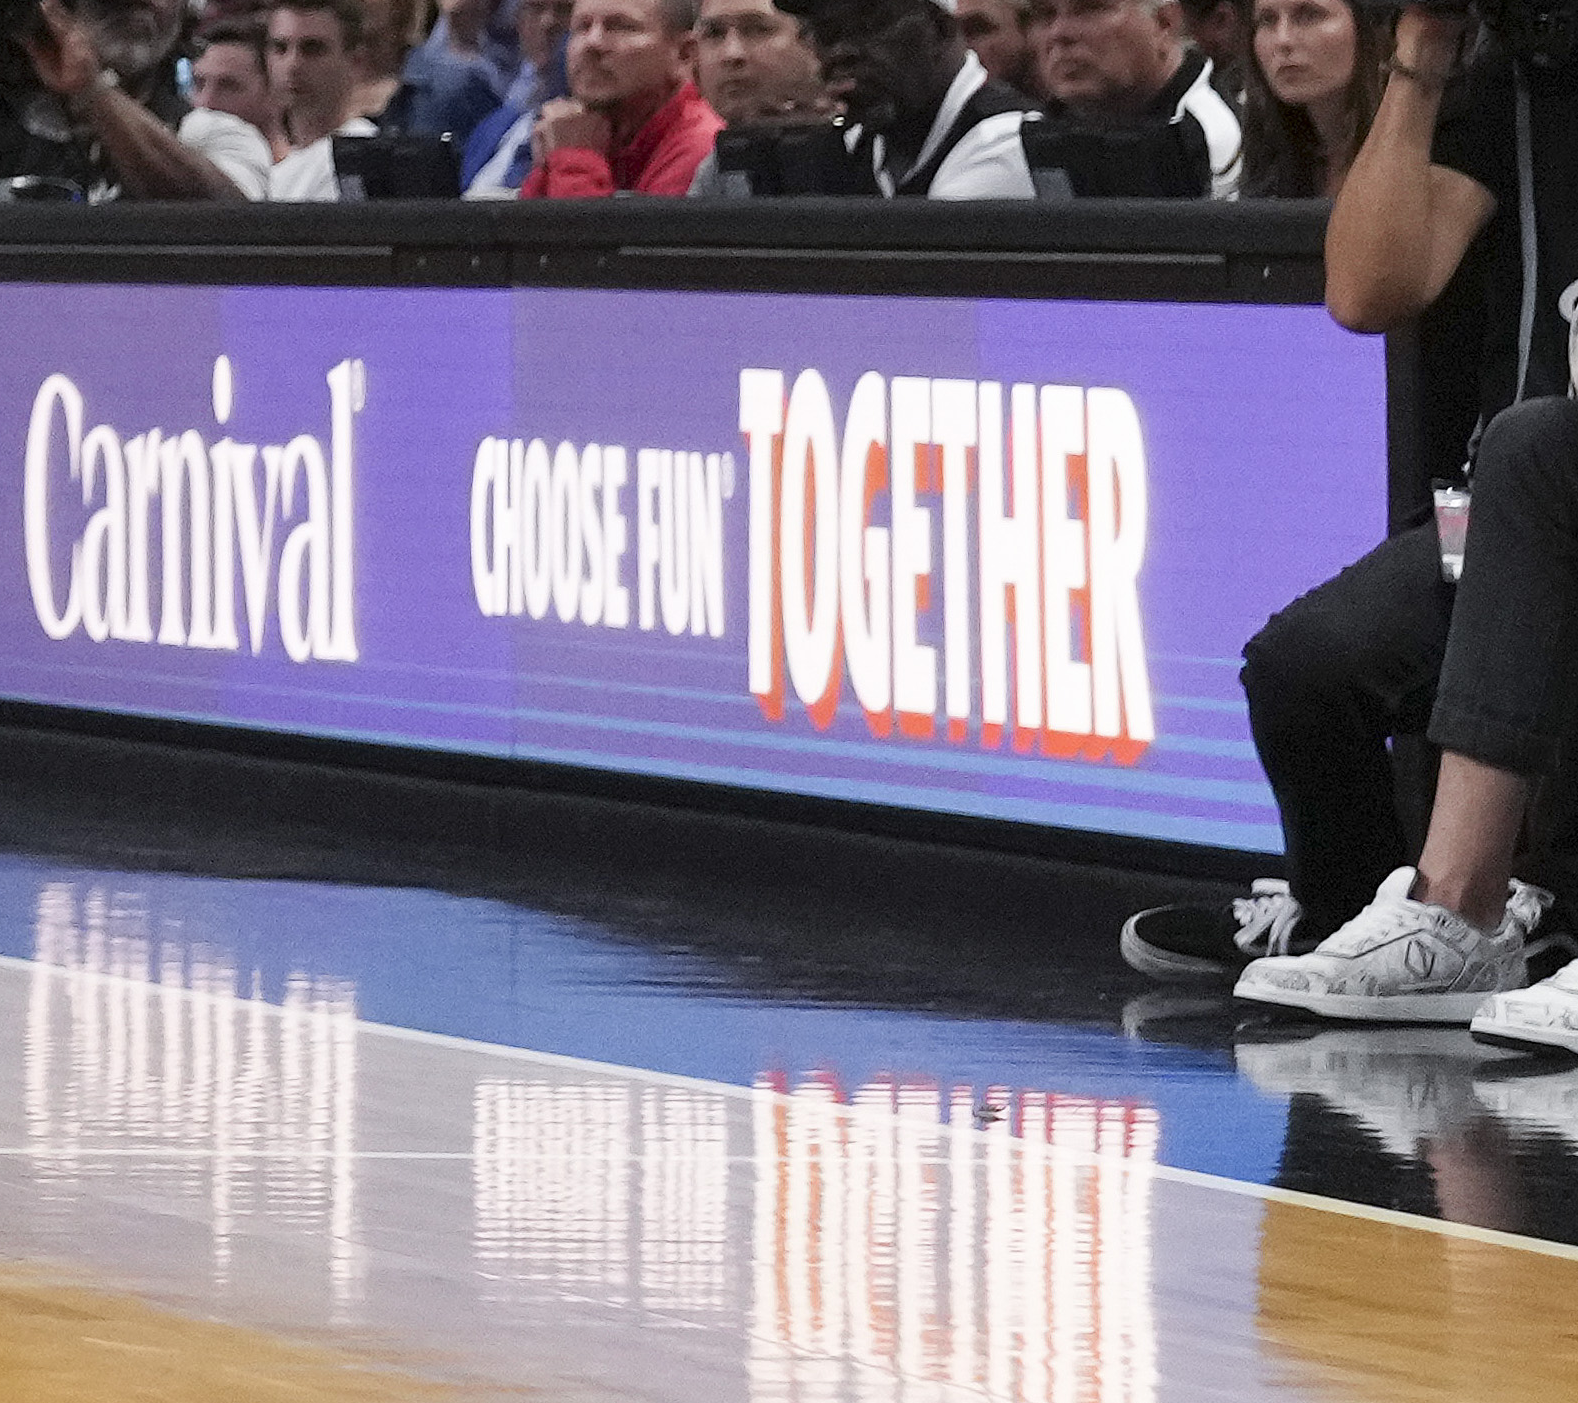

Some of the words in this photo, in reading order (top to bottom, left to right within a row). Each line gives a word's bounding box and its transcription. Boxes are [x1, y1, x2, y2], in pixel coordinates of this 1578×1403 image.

[23, 354, 361, 663] Carnival
[470, 436, 630, 630] CHOOSE
[636, 448, 726, 639] FUN
[738, 367, 1155, 749] TOGETHER
